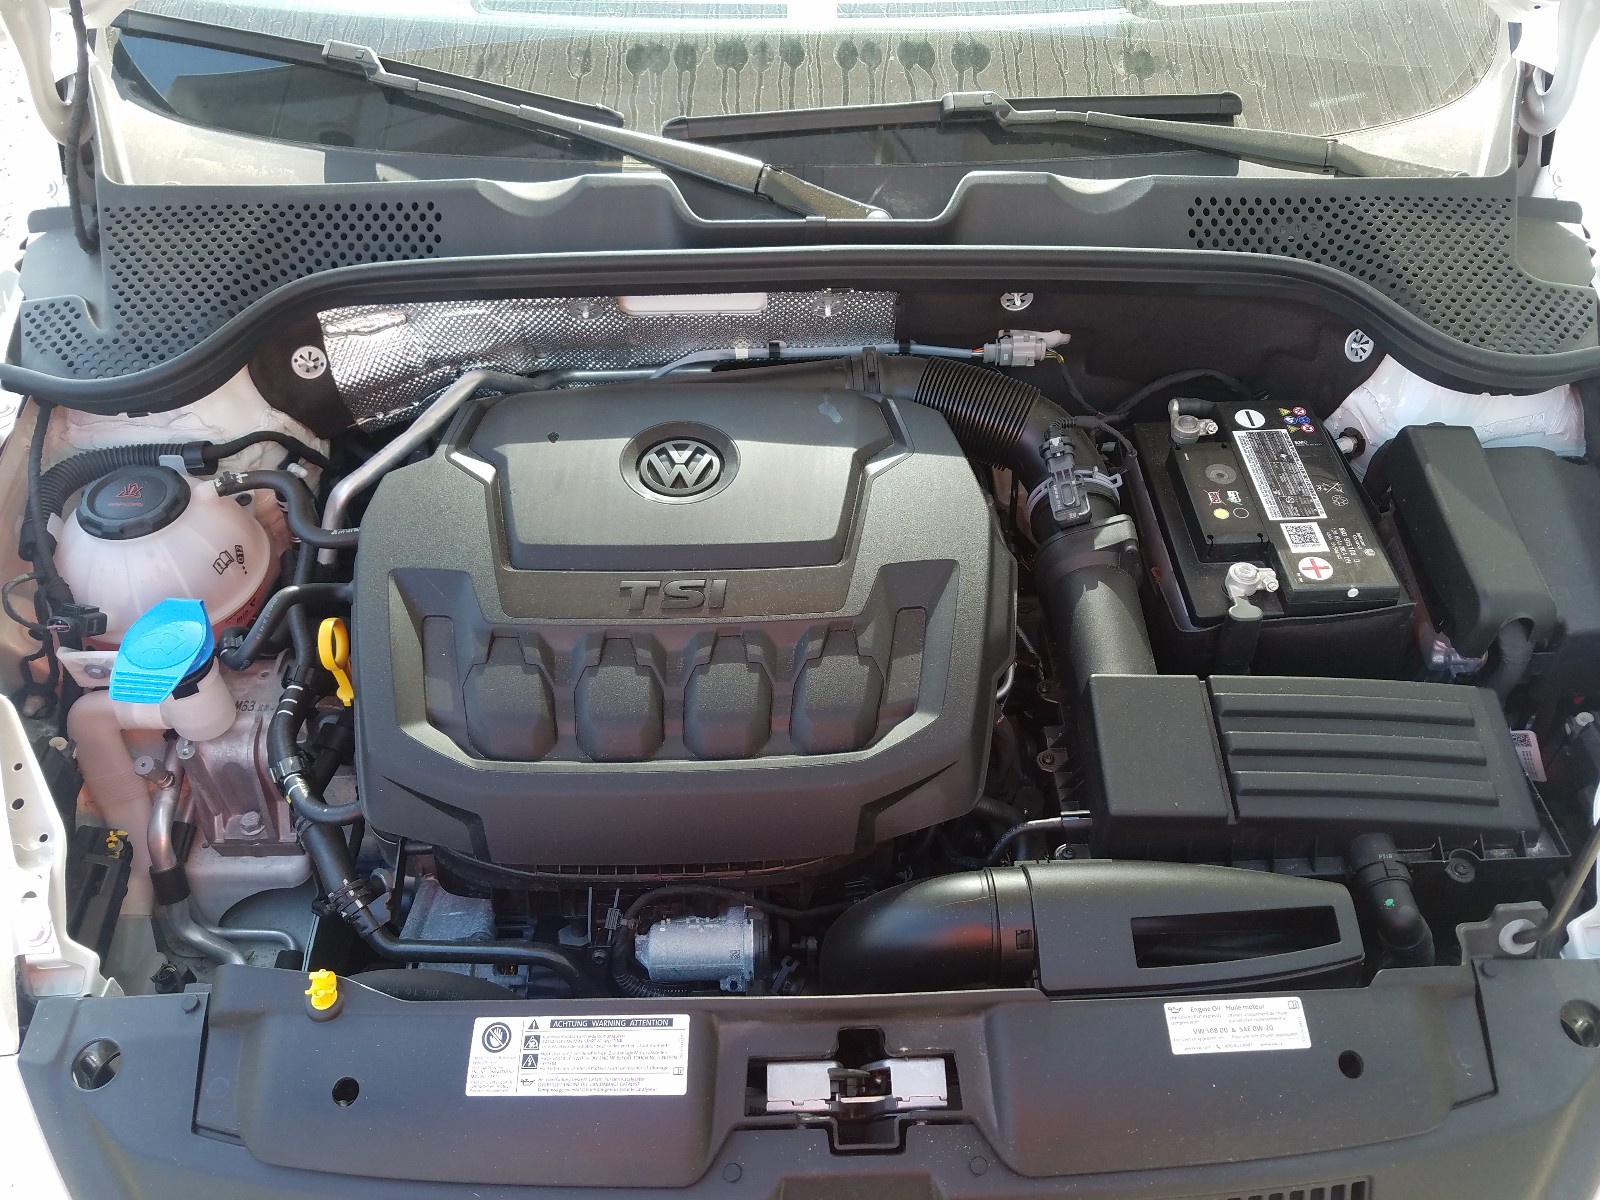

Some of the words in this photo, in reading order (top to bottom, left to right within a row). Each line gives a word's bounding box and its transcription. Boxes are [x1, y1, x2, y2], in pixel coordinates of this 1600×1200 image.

[619, 579, 728, 611] TSI
[553, 1020, 588, 1028] ACHTUNG
[592, 1019, 626, 1028] WARNING
[629, 1018, 669, 1027] ATTENTION
